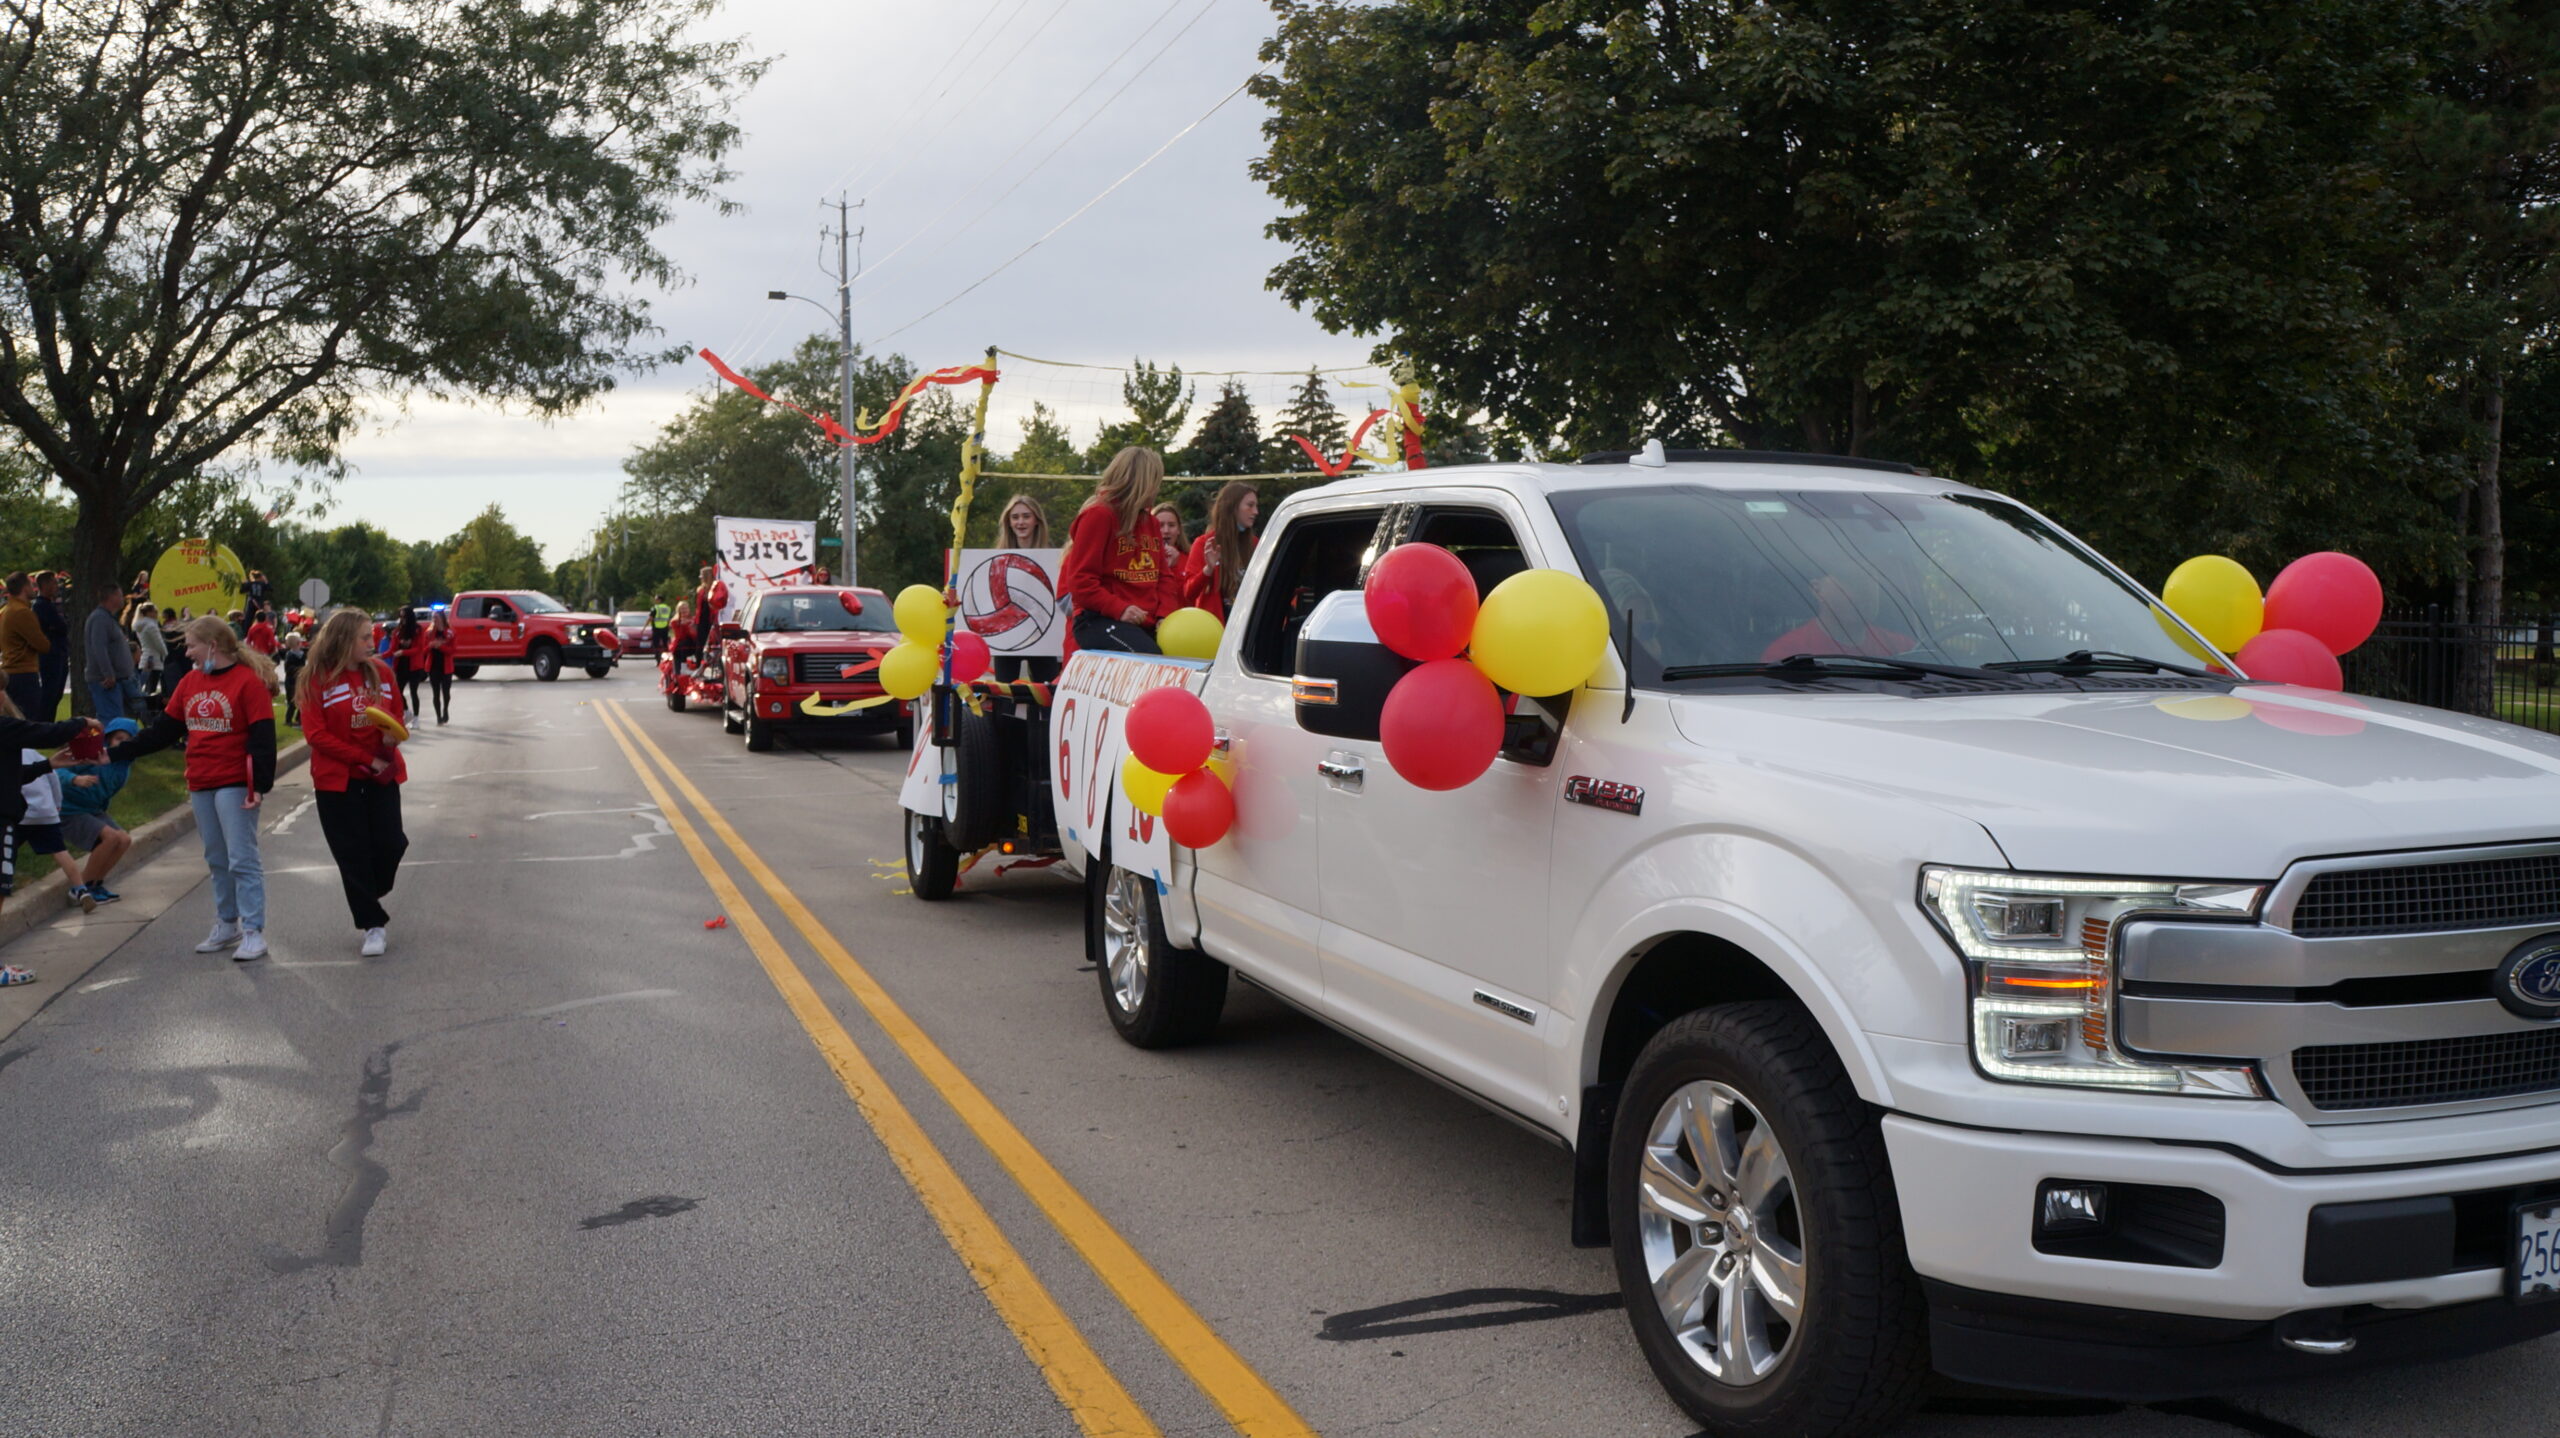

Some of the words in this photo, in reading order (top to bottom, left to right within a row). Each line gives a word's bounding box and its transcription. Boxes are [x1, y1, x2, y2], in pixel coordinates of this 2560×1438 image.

[174, 582, 218, 597] BATAVIA
[1059, 698, 1076, 802] 6
[1087, 707, 1109, 829] 8
